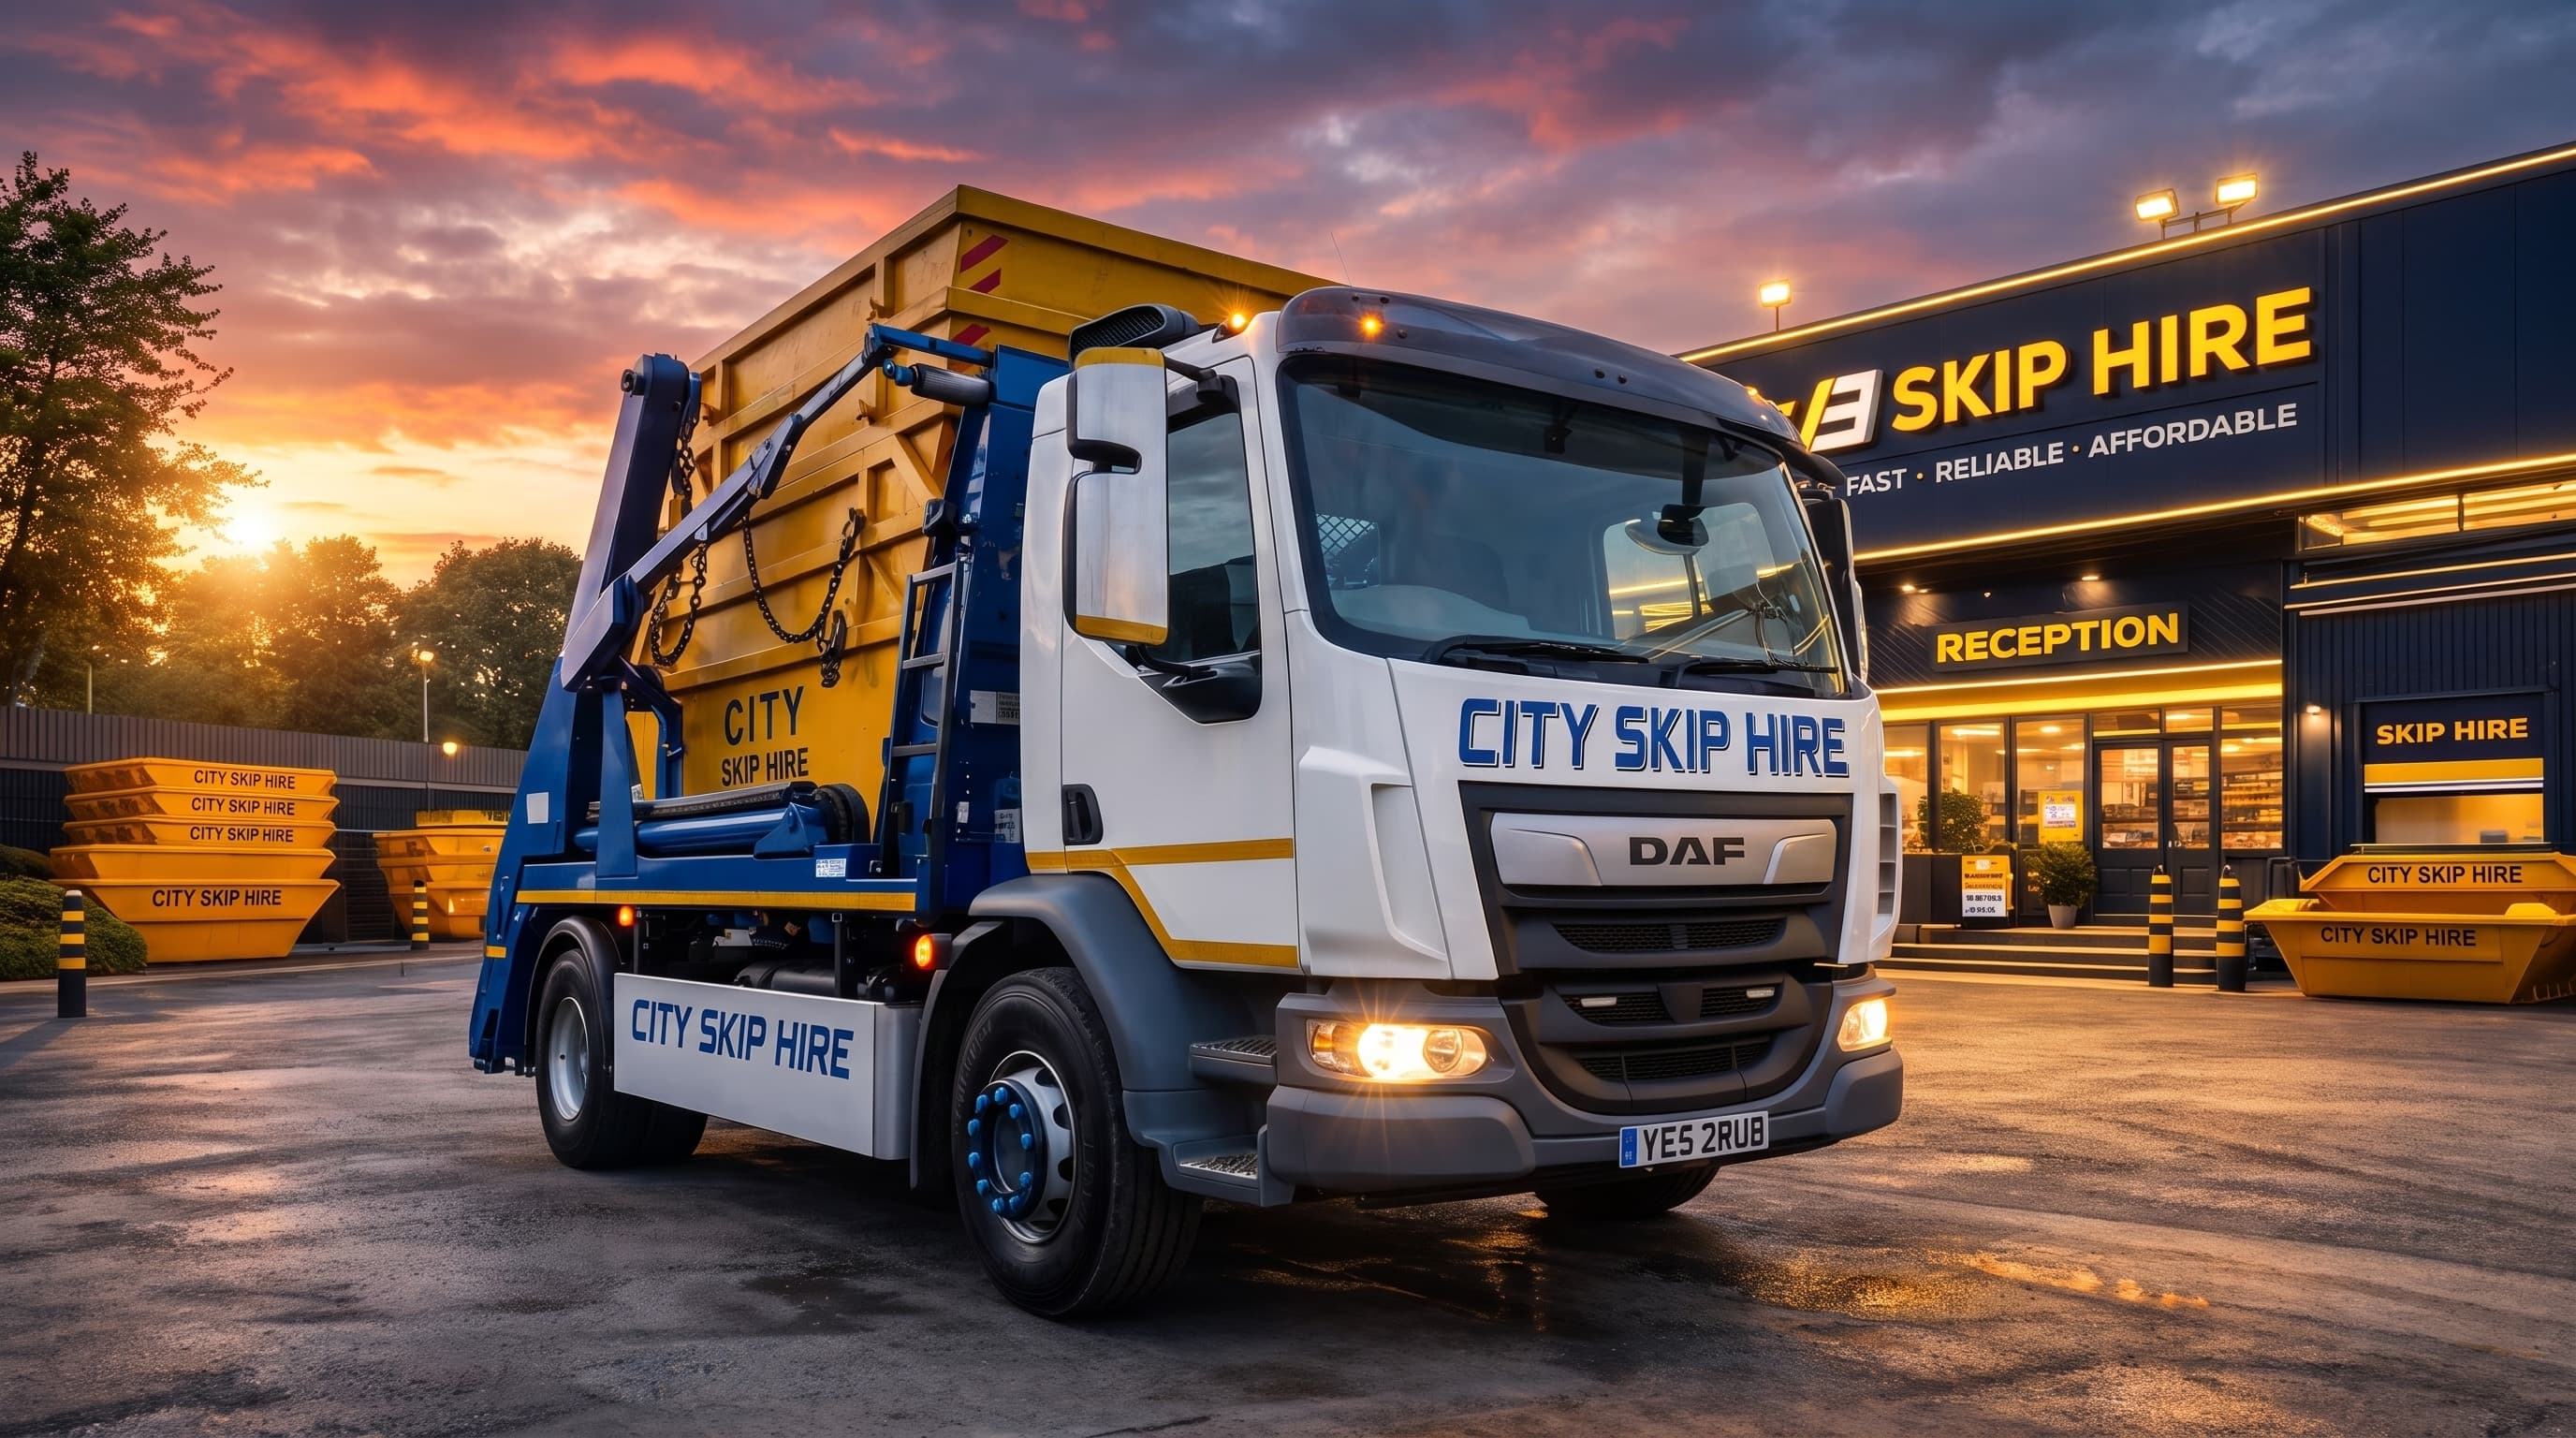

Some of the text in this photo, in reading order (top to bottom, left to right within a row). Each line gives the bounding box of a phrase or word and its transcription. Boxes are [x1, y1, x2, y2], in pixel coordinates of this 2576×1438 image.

[1891, 340, 2069, 433] SKIP
[2092, 286, 2312, 396] HIRE
[1846, 403, 2298, 497] FAST RELIABLE AFFORDABLE
[1936, 610, 2179, 666] RECEPTION
[724, 685, 805, 747] CITY
[2376, 717, 2529, 745] SKIP HIRE
[1457, 697, 1851, 779] CITY SKIP HIRE
[193, 770, 296, 789] CITY SKIP HIRE
[721, 746, 810, 786] SKIP HIRE
[191, 797, 295, 816] CITY SKIP HIRE
[189, 826, 294, 843] CITY SKIP HIRE
[1629, 836, 1745, 866] DAF
[2367, 863, 2524, 884] CITY SKIP HIRE
[152, 888, 283, 907] CITY SKIP HIRE
[2320, 925, 2477, 947] CITY SKIP HIRE
[632, 999, 855, 1079] CITY SKIP HIRE
[1701, 1116, 1764, 1154] 2RUB
